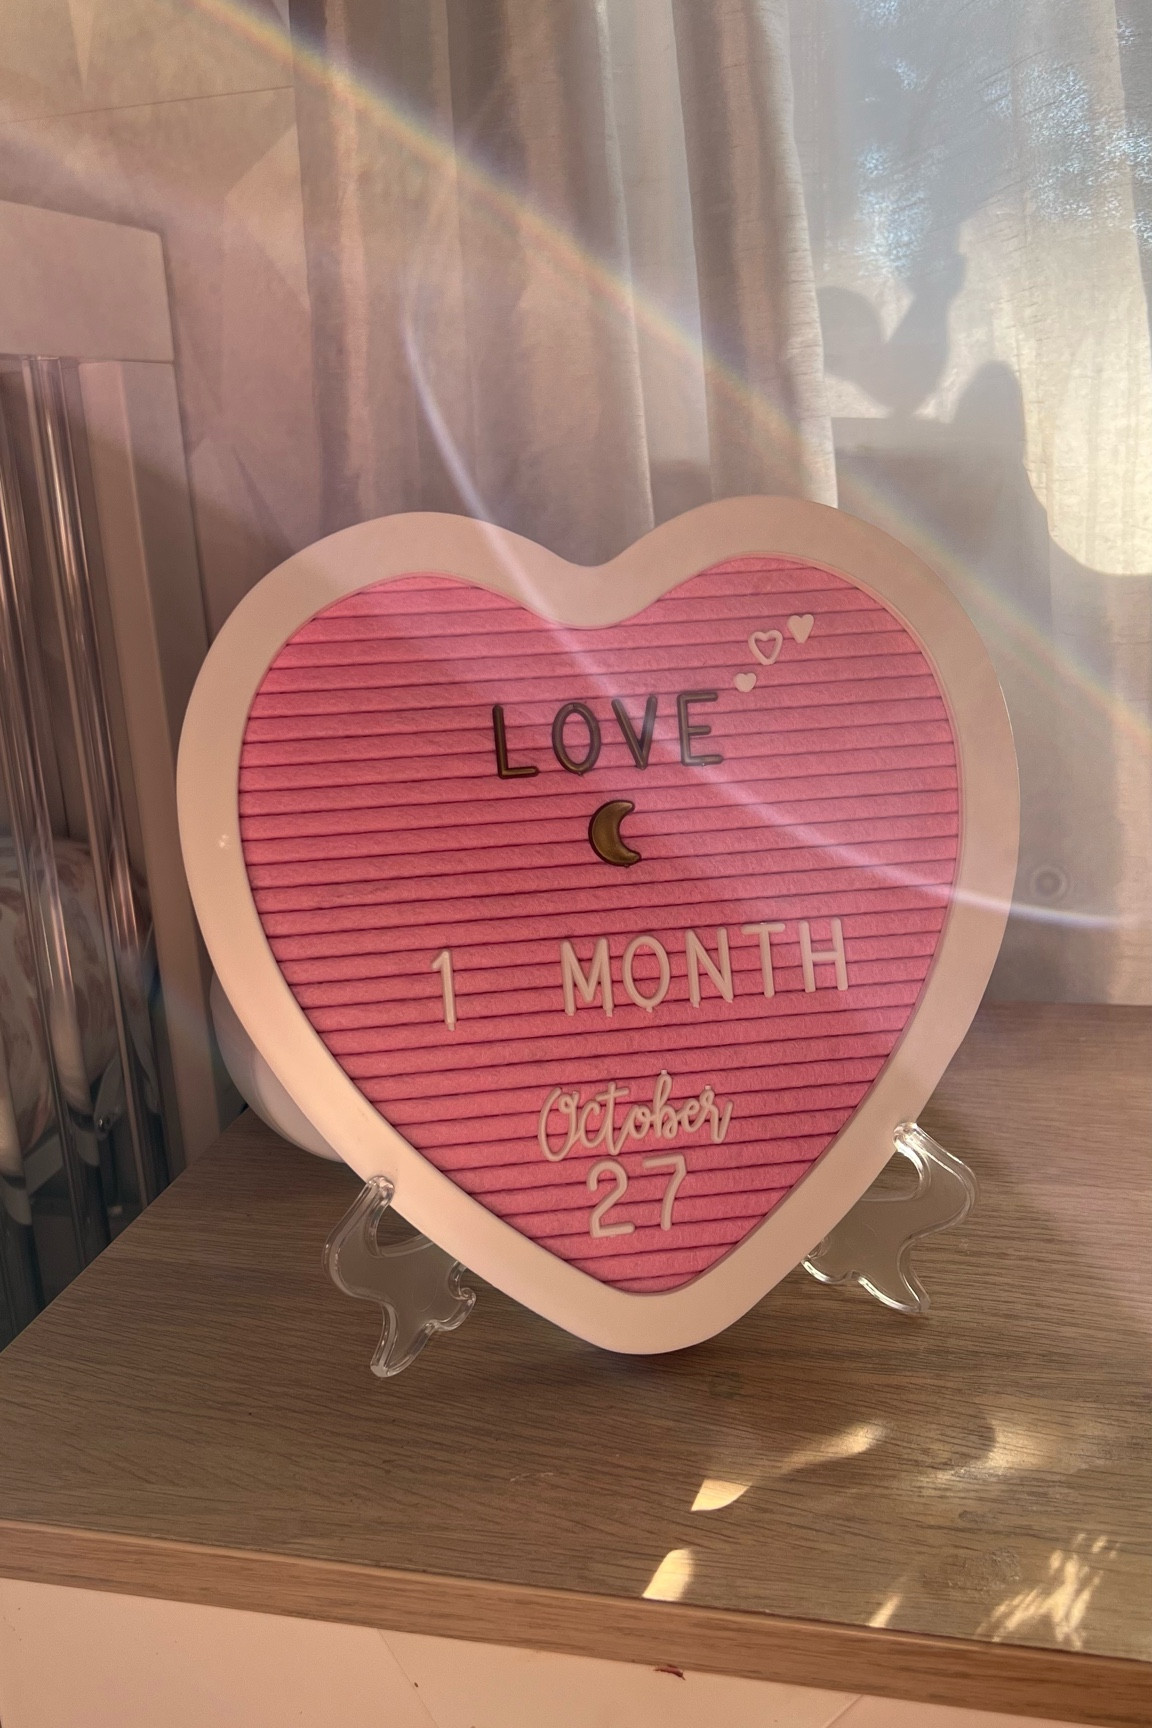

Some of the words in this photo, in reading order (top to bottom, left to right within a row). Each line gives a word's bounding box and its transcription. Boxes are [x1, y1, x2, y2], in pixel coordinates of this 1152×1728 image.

[492, 691, 724, 779] LOVE
[431, 949, 457, 1031] 1
[560, 917, 848, 1017] MONTH
[538, 1069, 733, 1162] October
[586, 1153, 687, 1238] 27
